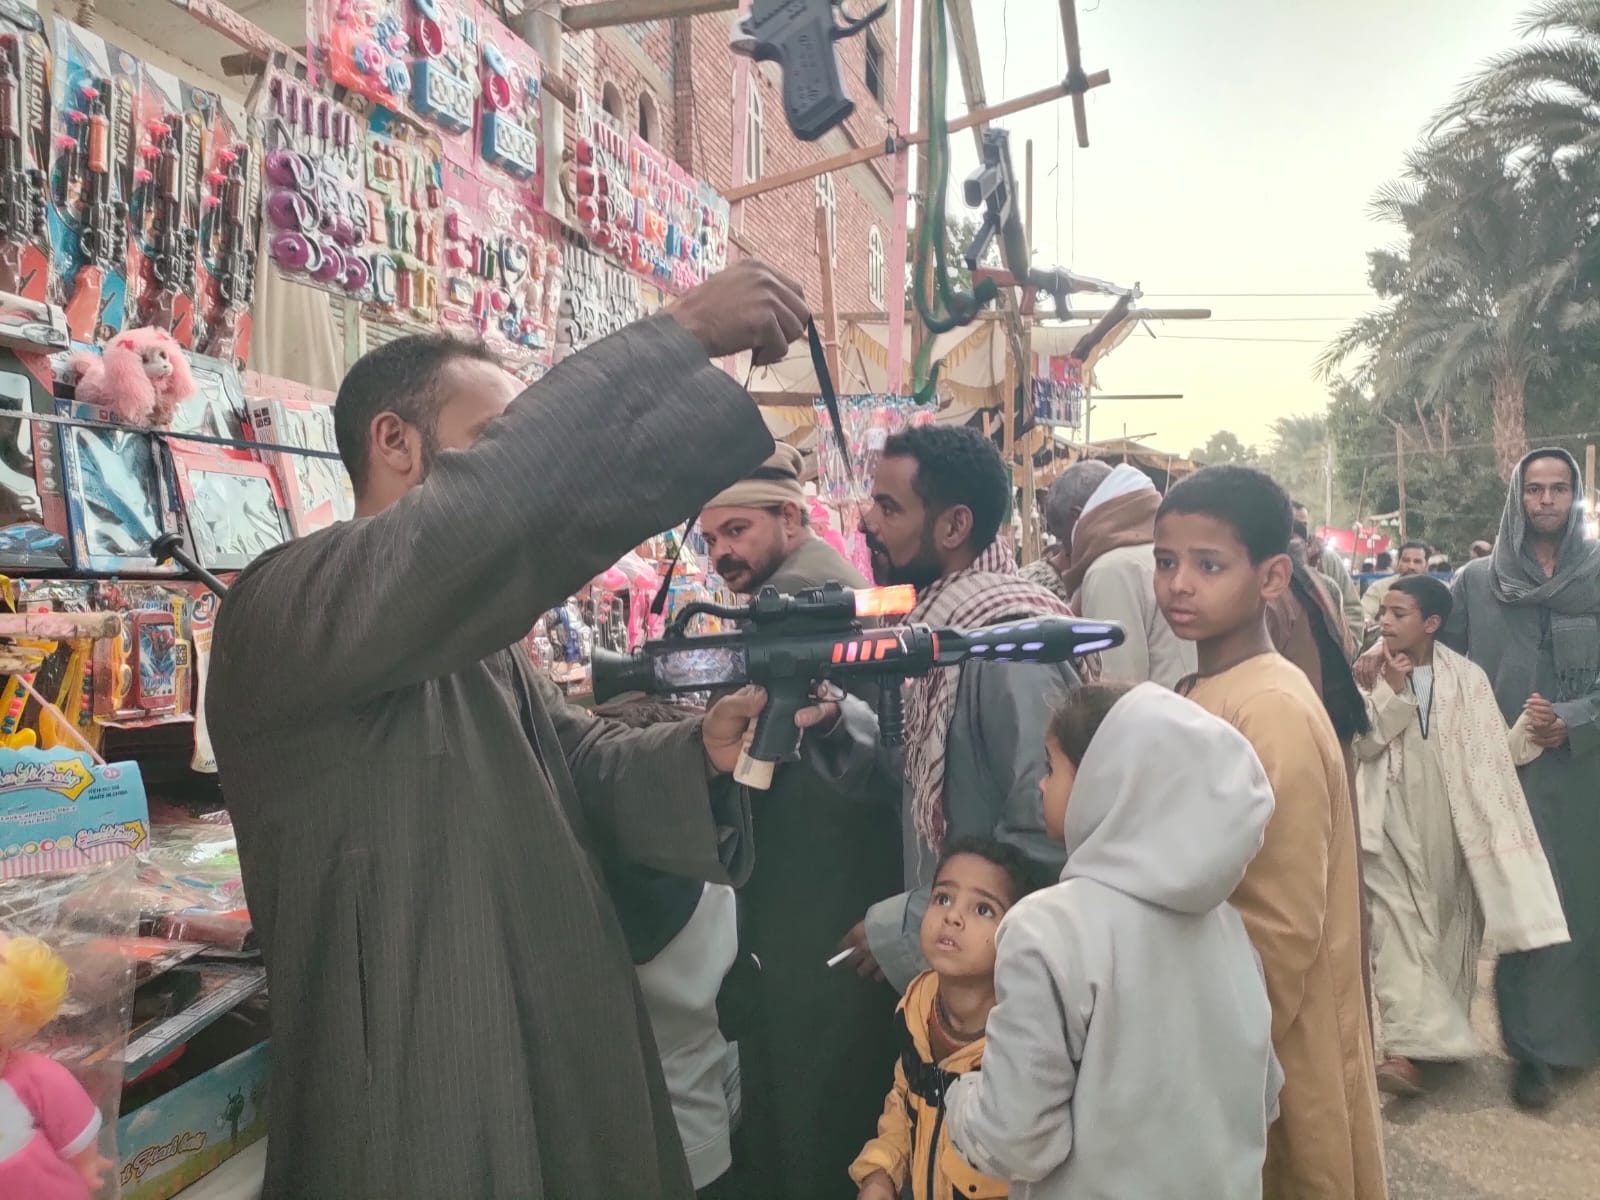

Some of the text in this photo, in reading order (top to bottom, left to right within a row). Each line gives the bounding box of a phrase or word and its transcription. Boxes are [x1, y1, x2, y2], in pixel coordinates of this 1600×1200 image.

[30, 44, 45, 130] AIR GUN
[119, 90, 133, 122] AIR
[116, 124, 131, 165] GUN
[189, 121, 202, 157] AIR
[184, 156, 198, 193] GUN
[247, 181, 260, 217] GUN
